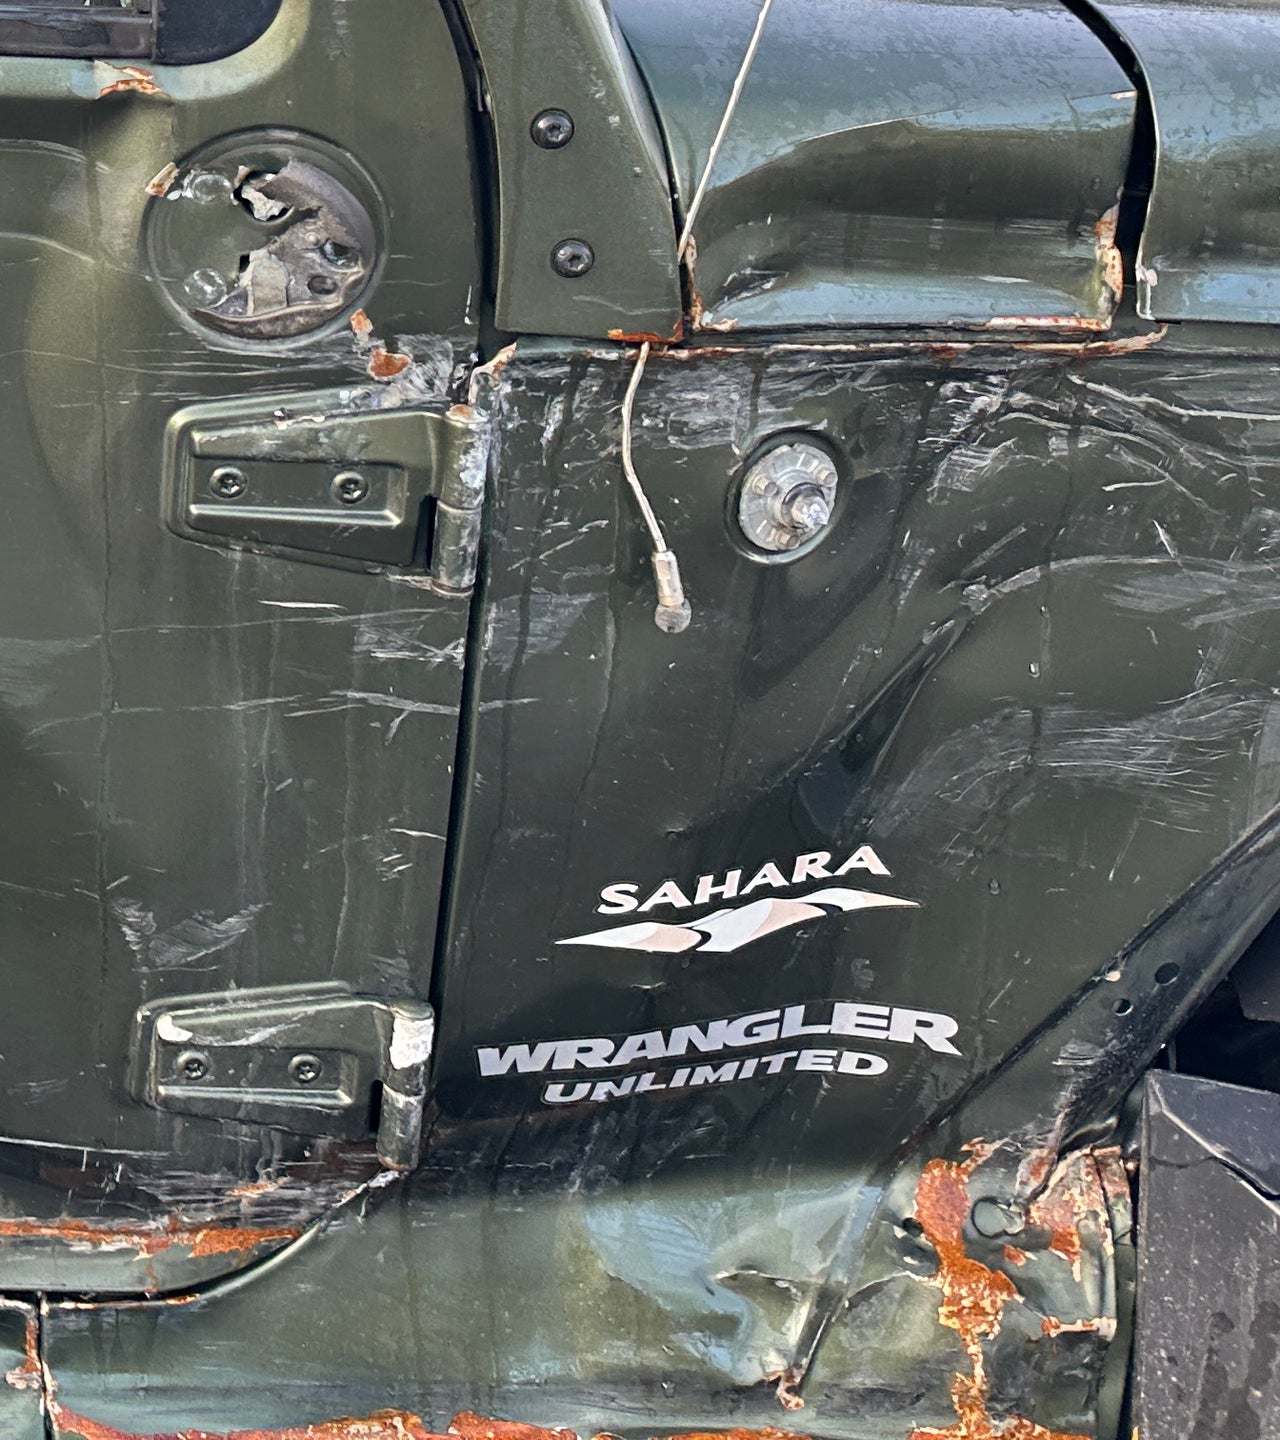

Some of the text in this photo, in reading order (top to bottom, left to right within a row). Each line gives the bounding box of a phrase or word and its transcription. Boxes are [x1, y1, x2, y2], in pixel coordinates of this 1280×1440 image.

[595, 843, 892, 915] SAHARA
[476, 1002, 962, 1077] WRANGLER
[543, 1049, 889, 1104] UNLIMITED
